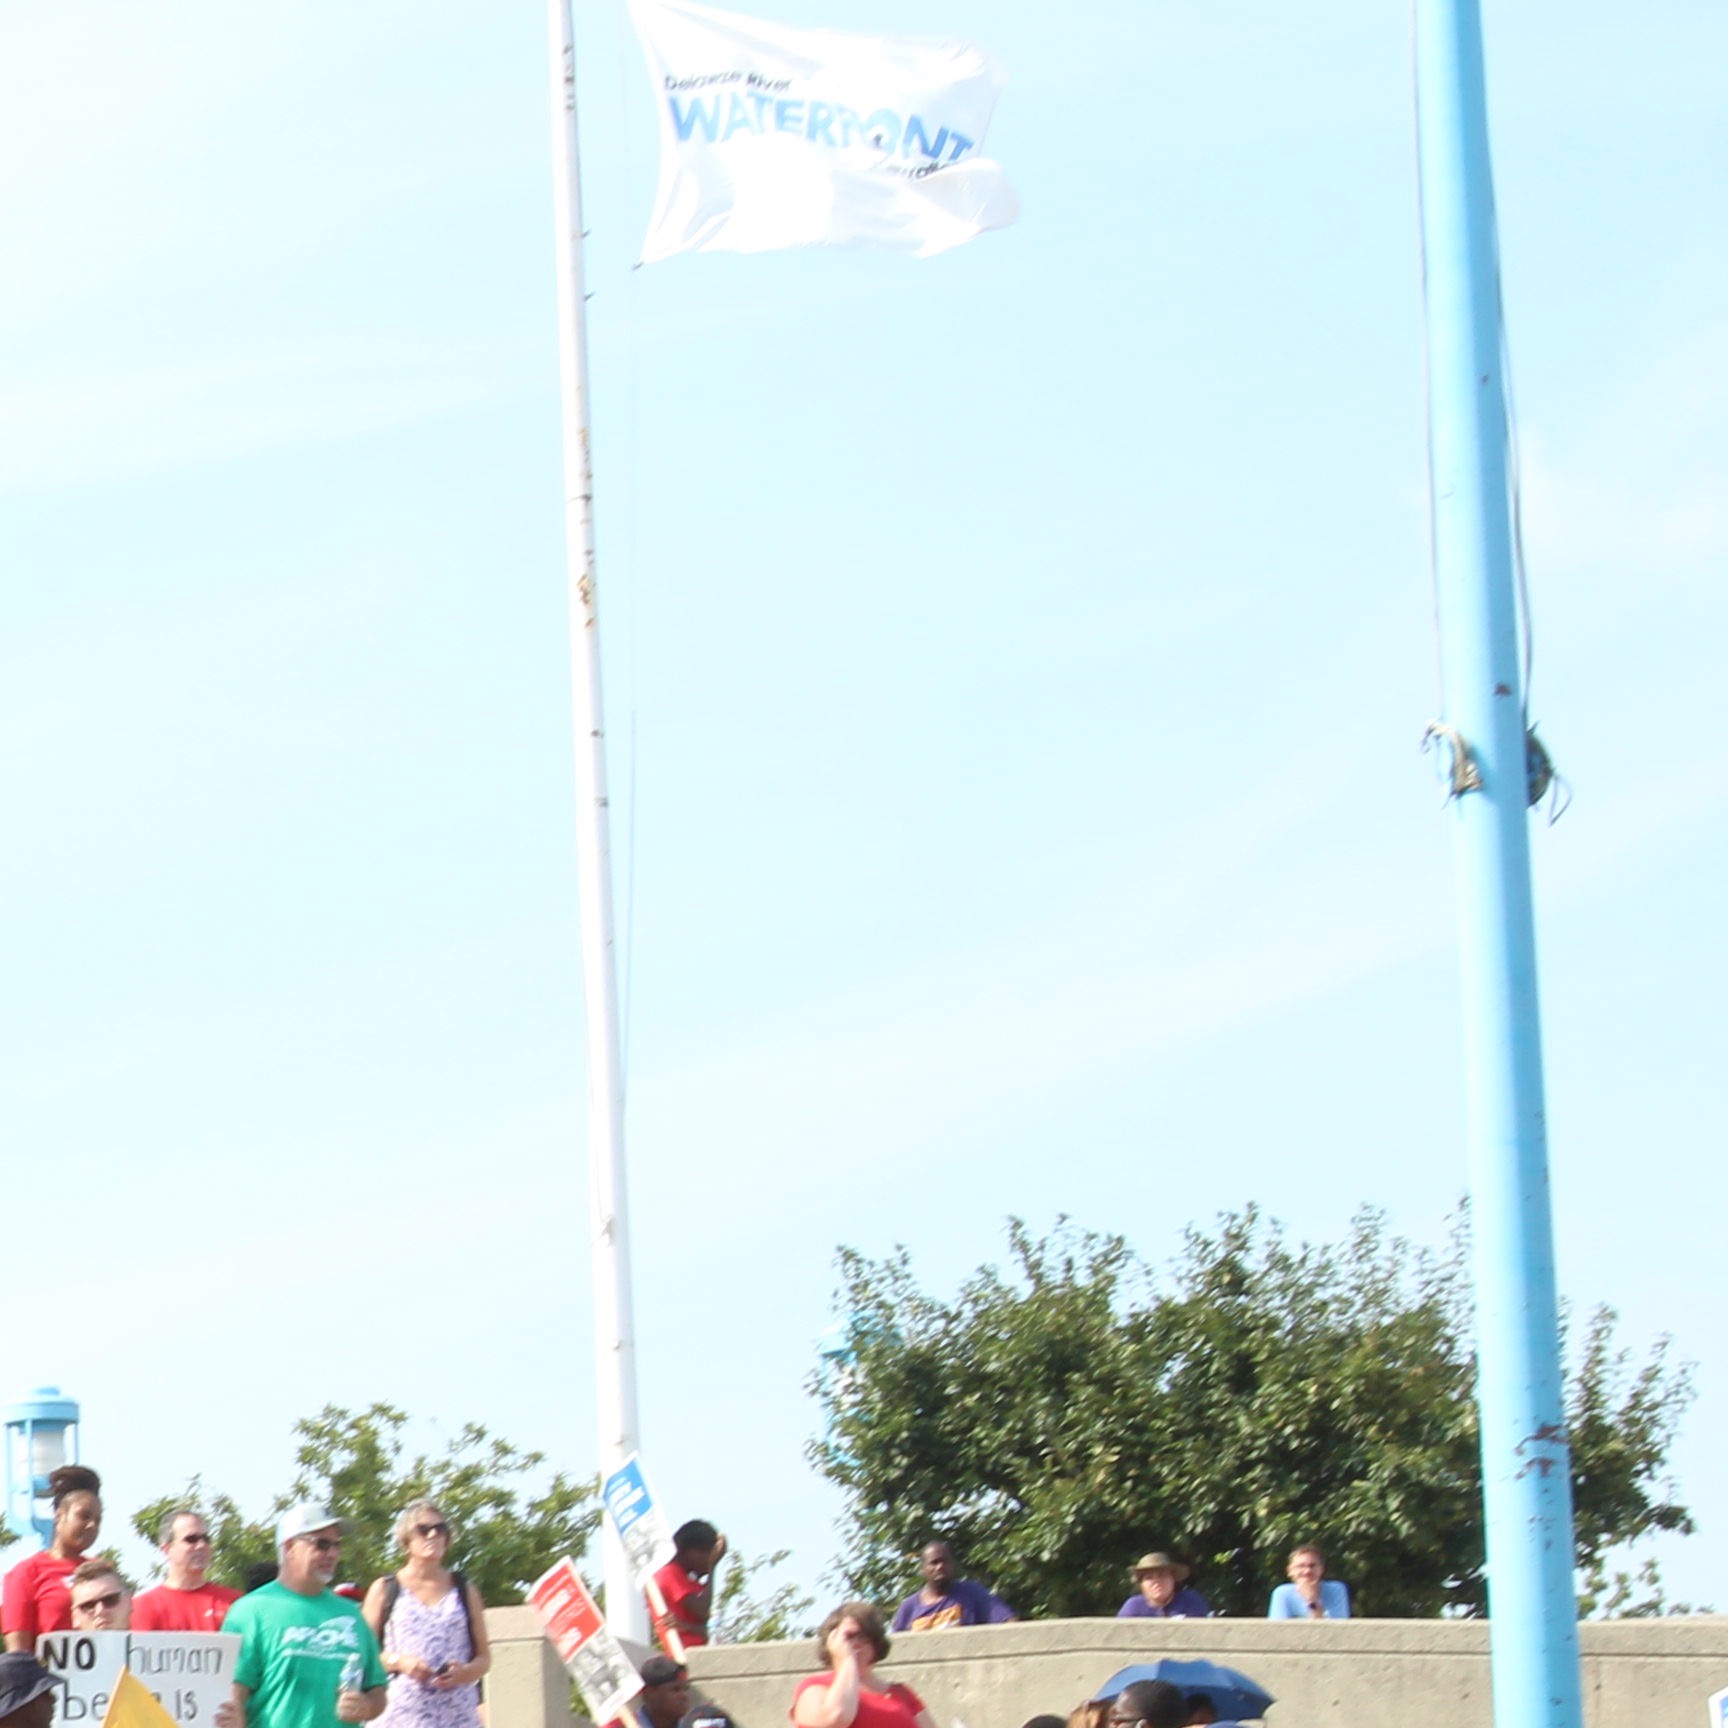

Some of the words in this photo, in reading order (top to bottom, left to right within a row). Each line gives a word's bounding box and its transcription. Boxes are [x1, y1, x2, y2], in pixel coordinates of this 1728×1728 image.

[746, 72, 793, 92] River
[44, 1637, 96, 1671] NO
[126, 1635, 223, 1675] human
